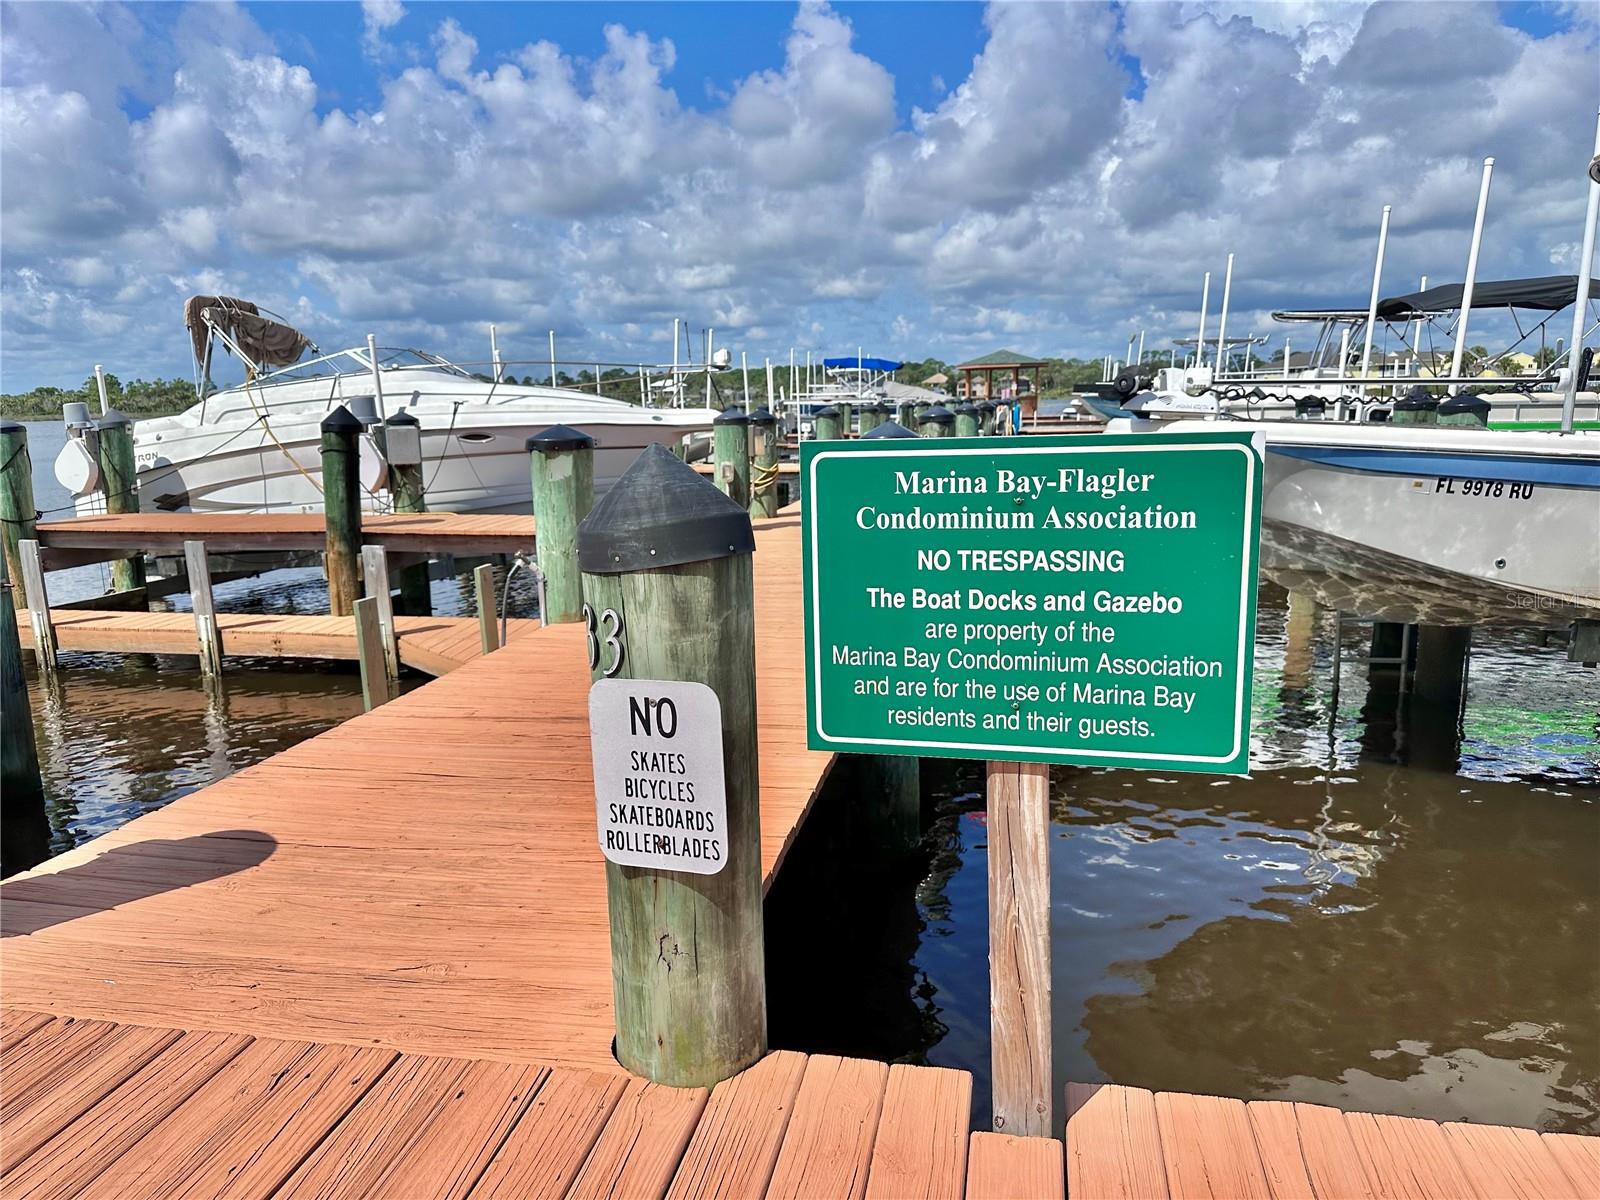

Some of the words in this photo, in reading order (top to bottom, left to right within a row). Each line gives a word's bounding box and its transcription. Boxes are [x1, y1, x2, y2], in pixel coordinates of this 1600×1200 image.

[894, 470, 988, 495] Marina
[996, 467, 1155, 502] Bay-Flagler
[1435, 477, 1455, 494] FL
[1461, 480, 1504, 498] 9978
[1508, 482, 1534, 500] RU
[856, 505, 1035, 530] Condominium
[1041, 504, 1197, 529] Association
[917, 549, 951, 571] NO
[956, 549, 1125, 573] TRESPASSING
[866, 587, 906, 609] The
[912, 588, 962, 610] Boat
[968, 588, 1037, 612] Docks
[1043, 590, 1086, 612] and
[1093, 590, 1183, 614] Gazebo
[925, 622, 958, 639] are
[963, 621, 1048, 647] property
[1054, 620, 1076, 642] of
[1081, 621, 1115, 643] the
[832, 644, 898, 667] Marina
[903, 646, 941, 673] Bay
[947, 648, 1089, 673] Condominium
[1095, 652, 1223, 678] Association
[854, 675, 889, 696] and
[895, 680, 927, 697] are
[932, 677, 960, 698] for
[964, 678, 997, 700] the
[1003, 685, 1040, 702] use
[1045, 681, 1067, 703] of
[1073, 682, 1146, 707] Marina
[1153, 685, 1196, 714] Bay
[629, 696, 678, 739] NO
[888, 705, 977, 729] residents
[982, 710, 1020, 731] and
[1026, 710, 1073, 733] their
[1078, 716, 1155, 739] guests.
[630, 750, 686, 775] SKATES
[624, 777, 695, 803] BICYCLES
[609, 802, 715, 833] SKATEBOARDS
[606, 829, 721, 861] ROLLERBLADES
